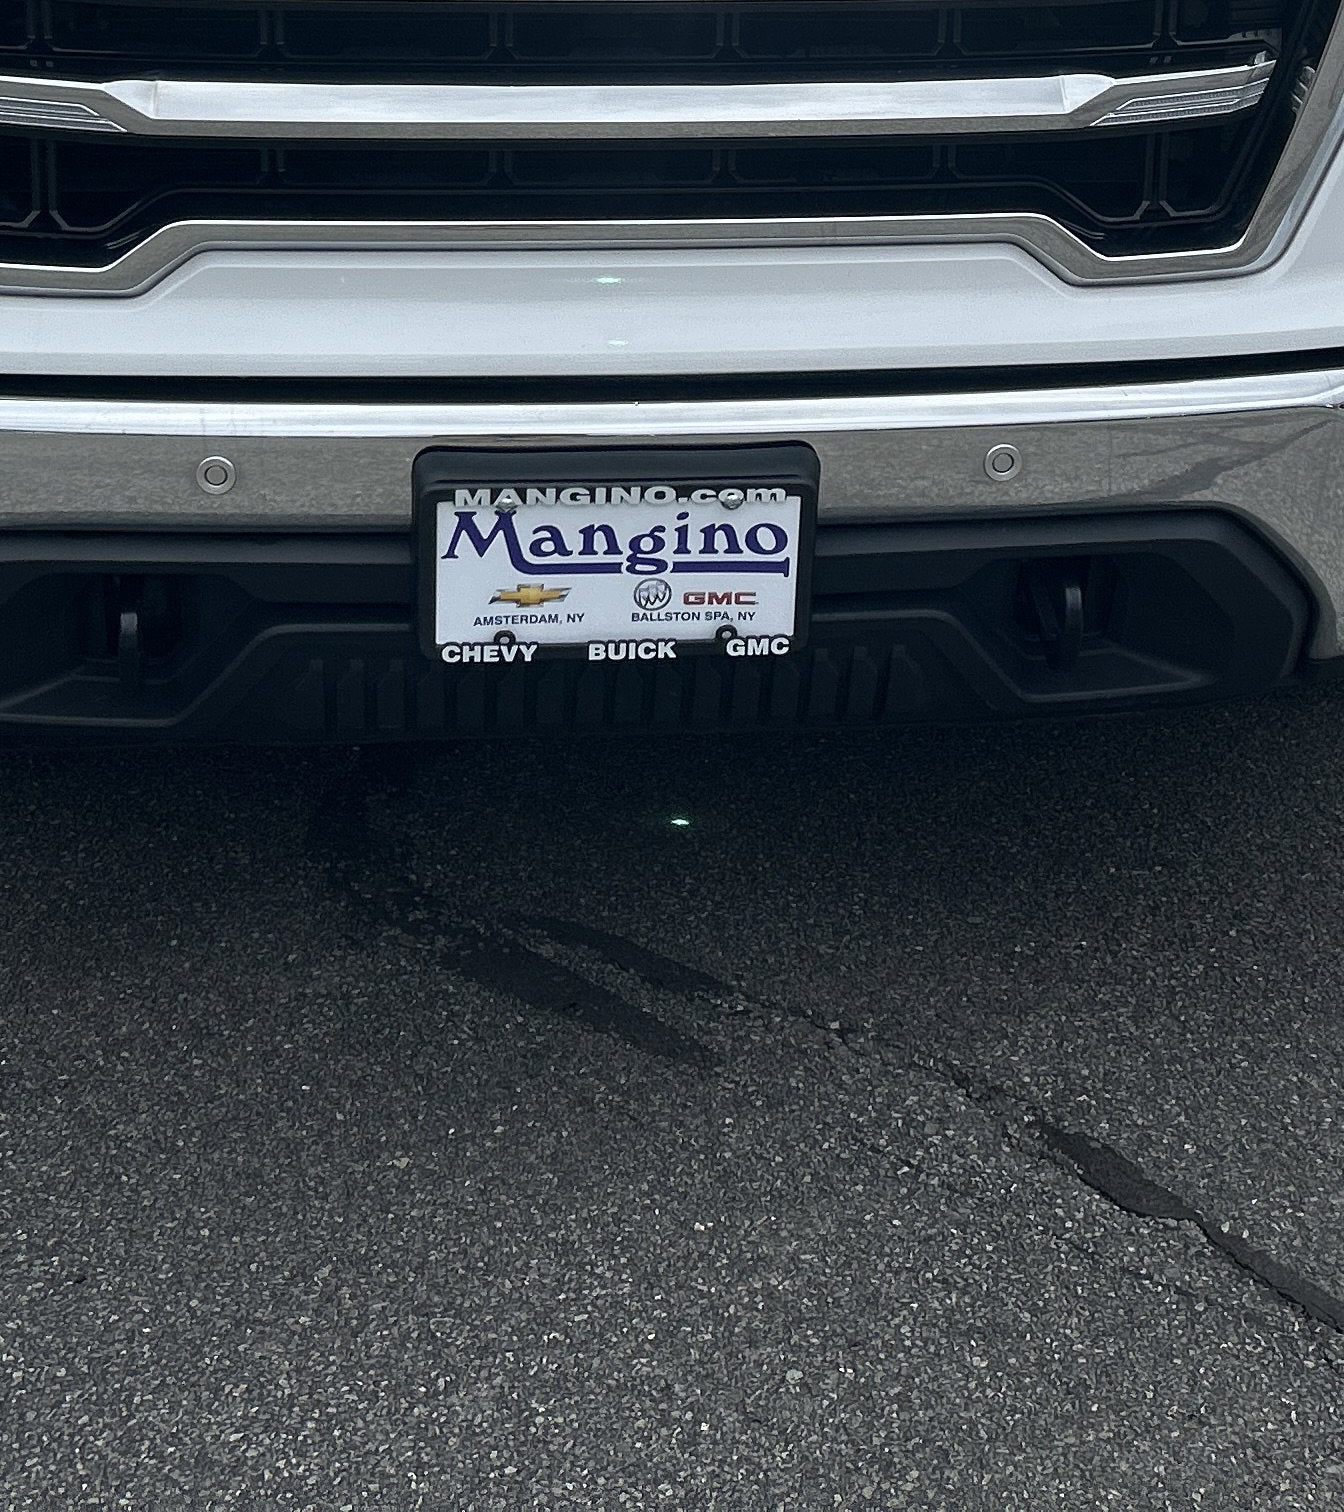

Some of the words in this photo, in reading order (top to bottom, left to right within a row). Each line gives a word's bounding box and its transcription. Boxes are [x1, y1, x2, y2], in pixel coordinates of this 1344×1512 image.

[440, 510, 790, 576] Mangino
[683, 591, 759, 606] GMC
[473, 614, 563, 627] AMSTERDAM,
[566, 612, 585, 624] NY
[631, 611, 702, 623] BALLSTON
[704, 610, 735, 623] SPA,
[737, 610, 757, 622] NY
[441, 643, 538, 664] CHEVY
[588, 641, 677, 661] BUICK
[726, 637, 790, 657] GMC
